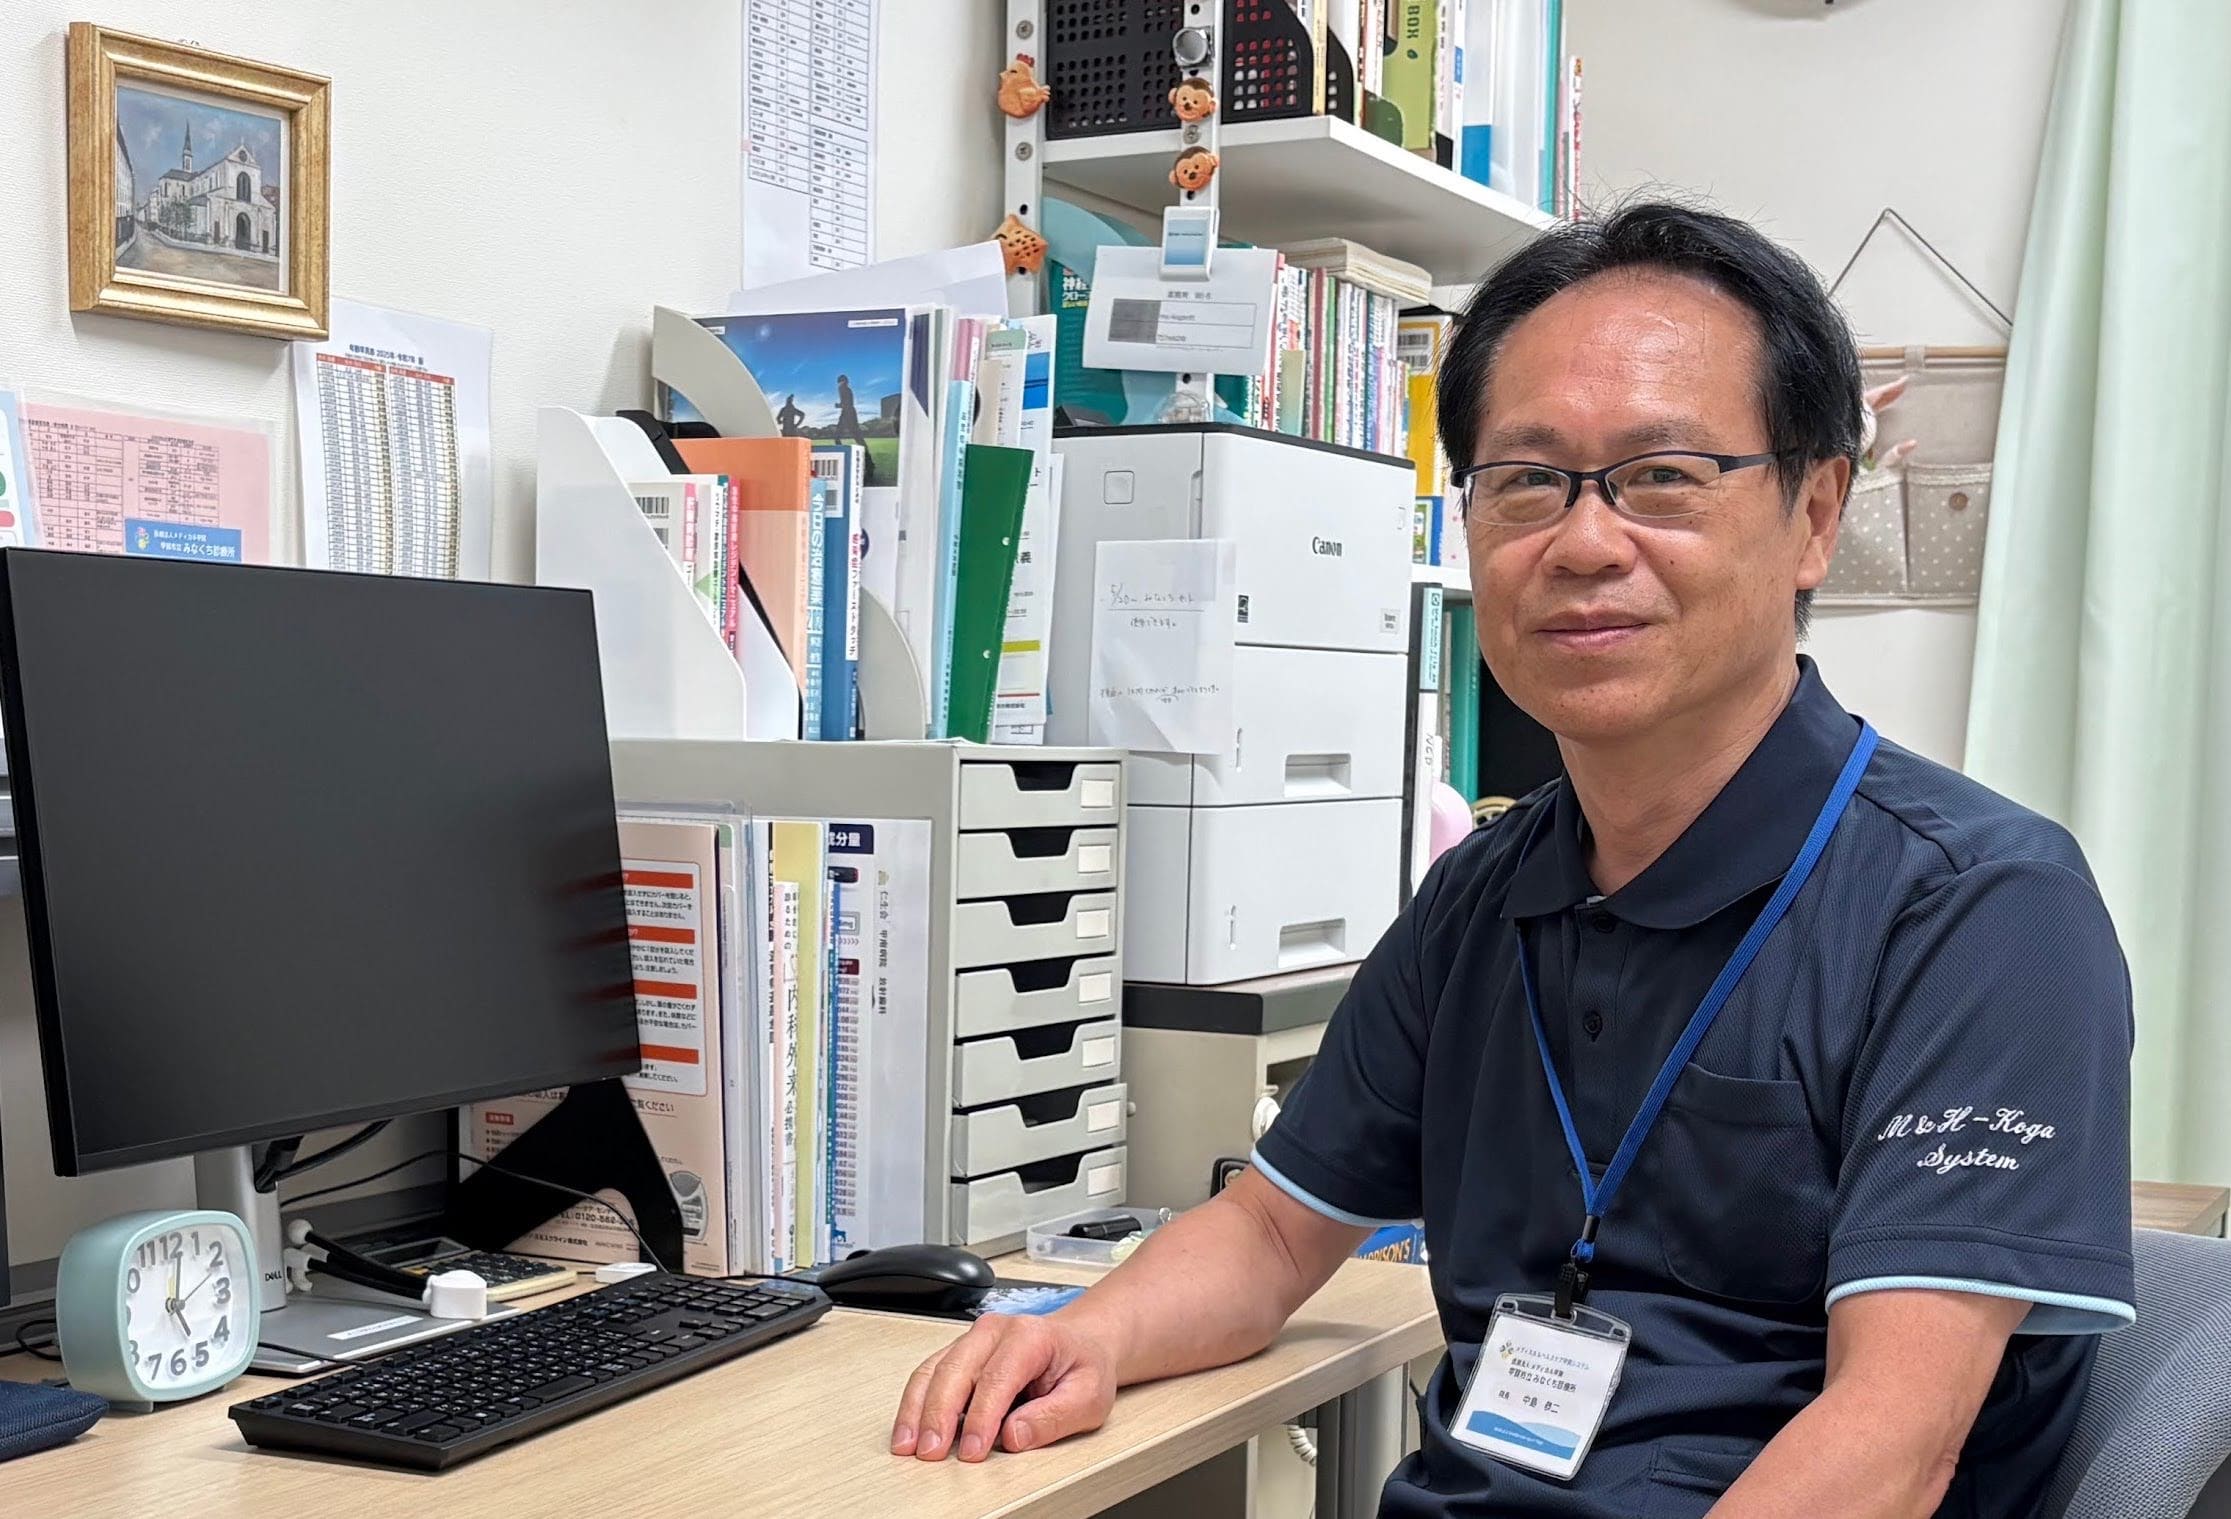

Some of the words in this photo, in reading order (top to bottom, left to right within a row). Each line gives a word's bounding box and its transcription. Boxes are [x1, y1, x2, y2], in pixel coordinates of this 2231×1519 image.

[1407, 5, 1420, 39] BOX
[1312, 536, 1342, 557] Canon
[1917, 1143, 2020, 1175] System
[137, 1242, 156, 1268] 11
[160, 1232, 183, 1260] 12
[191, 1231, 200, 1256] 1
[209, 1241, 224, 1268] 2
[1360, 1237, 1411, 1262] RISON'S
[127, 1268, 141, 1294] 0
[265, 1270, 283, 1282] DELL
[216, 1277, 231, 1304] 3
[214, 1315, 230, 1343] 4
[149, 1353, 162, 1381] 7
[170, 1349, 187, 1376] 6
[194, 1341, 210, 1368] 5
